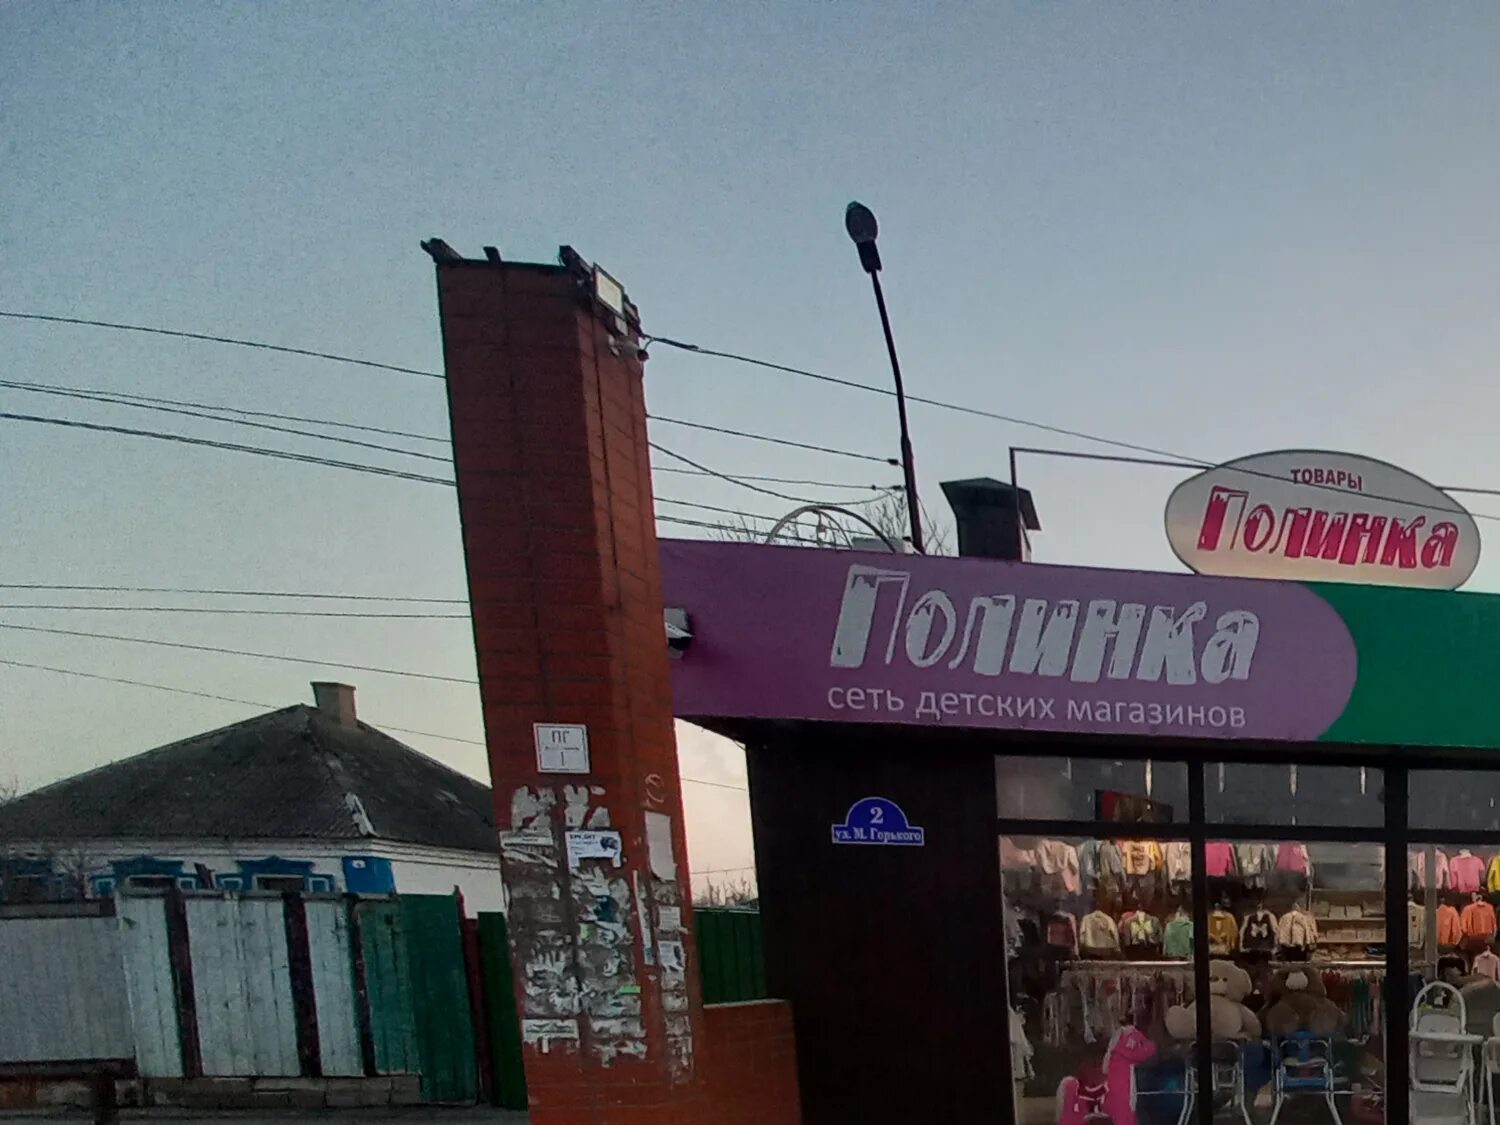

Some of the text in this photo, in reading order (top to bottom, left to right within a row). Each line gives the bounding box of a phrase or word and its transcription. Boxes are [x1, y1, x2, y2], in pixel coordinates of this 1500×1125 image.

[1290, 468, 1363, 491] ТОВАРЫ
[1196, 485, 1460, 570] Полинка
[829, 564, 1260, 685] Полинка
[827, 686, 1246, 728] сеть детских магазинов
[869, 806, 884, 824] 2
[870, 827, 921, 843] Горького
